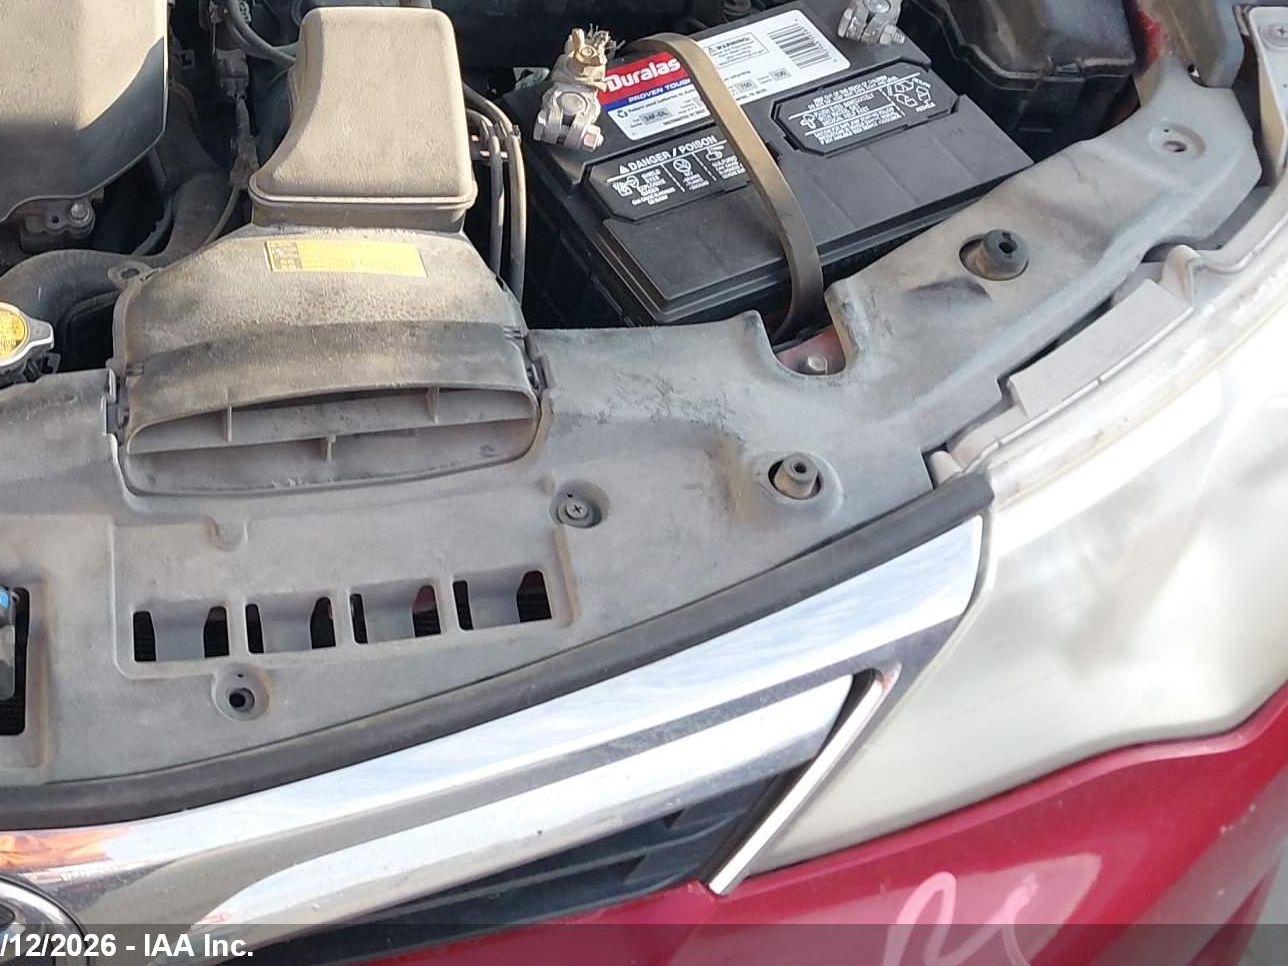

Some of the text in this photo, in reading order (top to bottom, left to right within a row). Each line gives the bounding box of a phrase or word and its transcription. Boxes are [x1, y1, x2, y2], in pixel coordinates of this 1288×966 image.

[628, 88, 664, 103] PROVEN
[628, 151, 671, 171] DANGER
[678, 135, 718, 154] POISON
